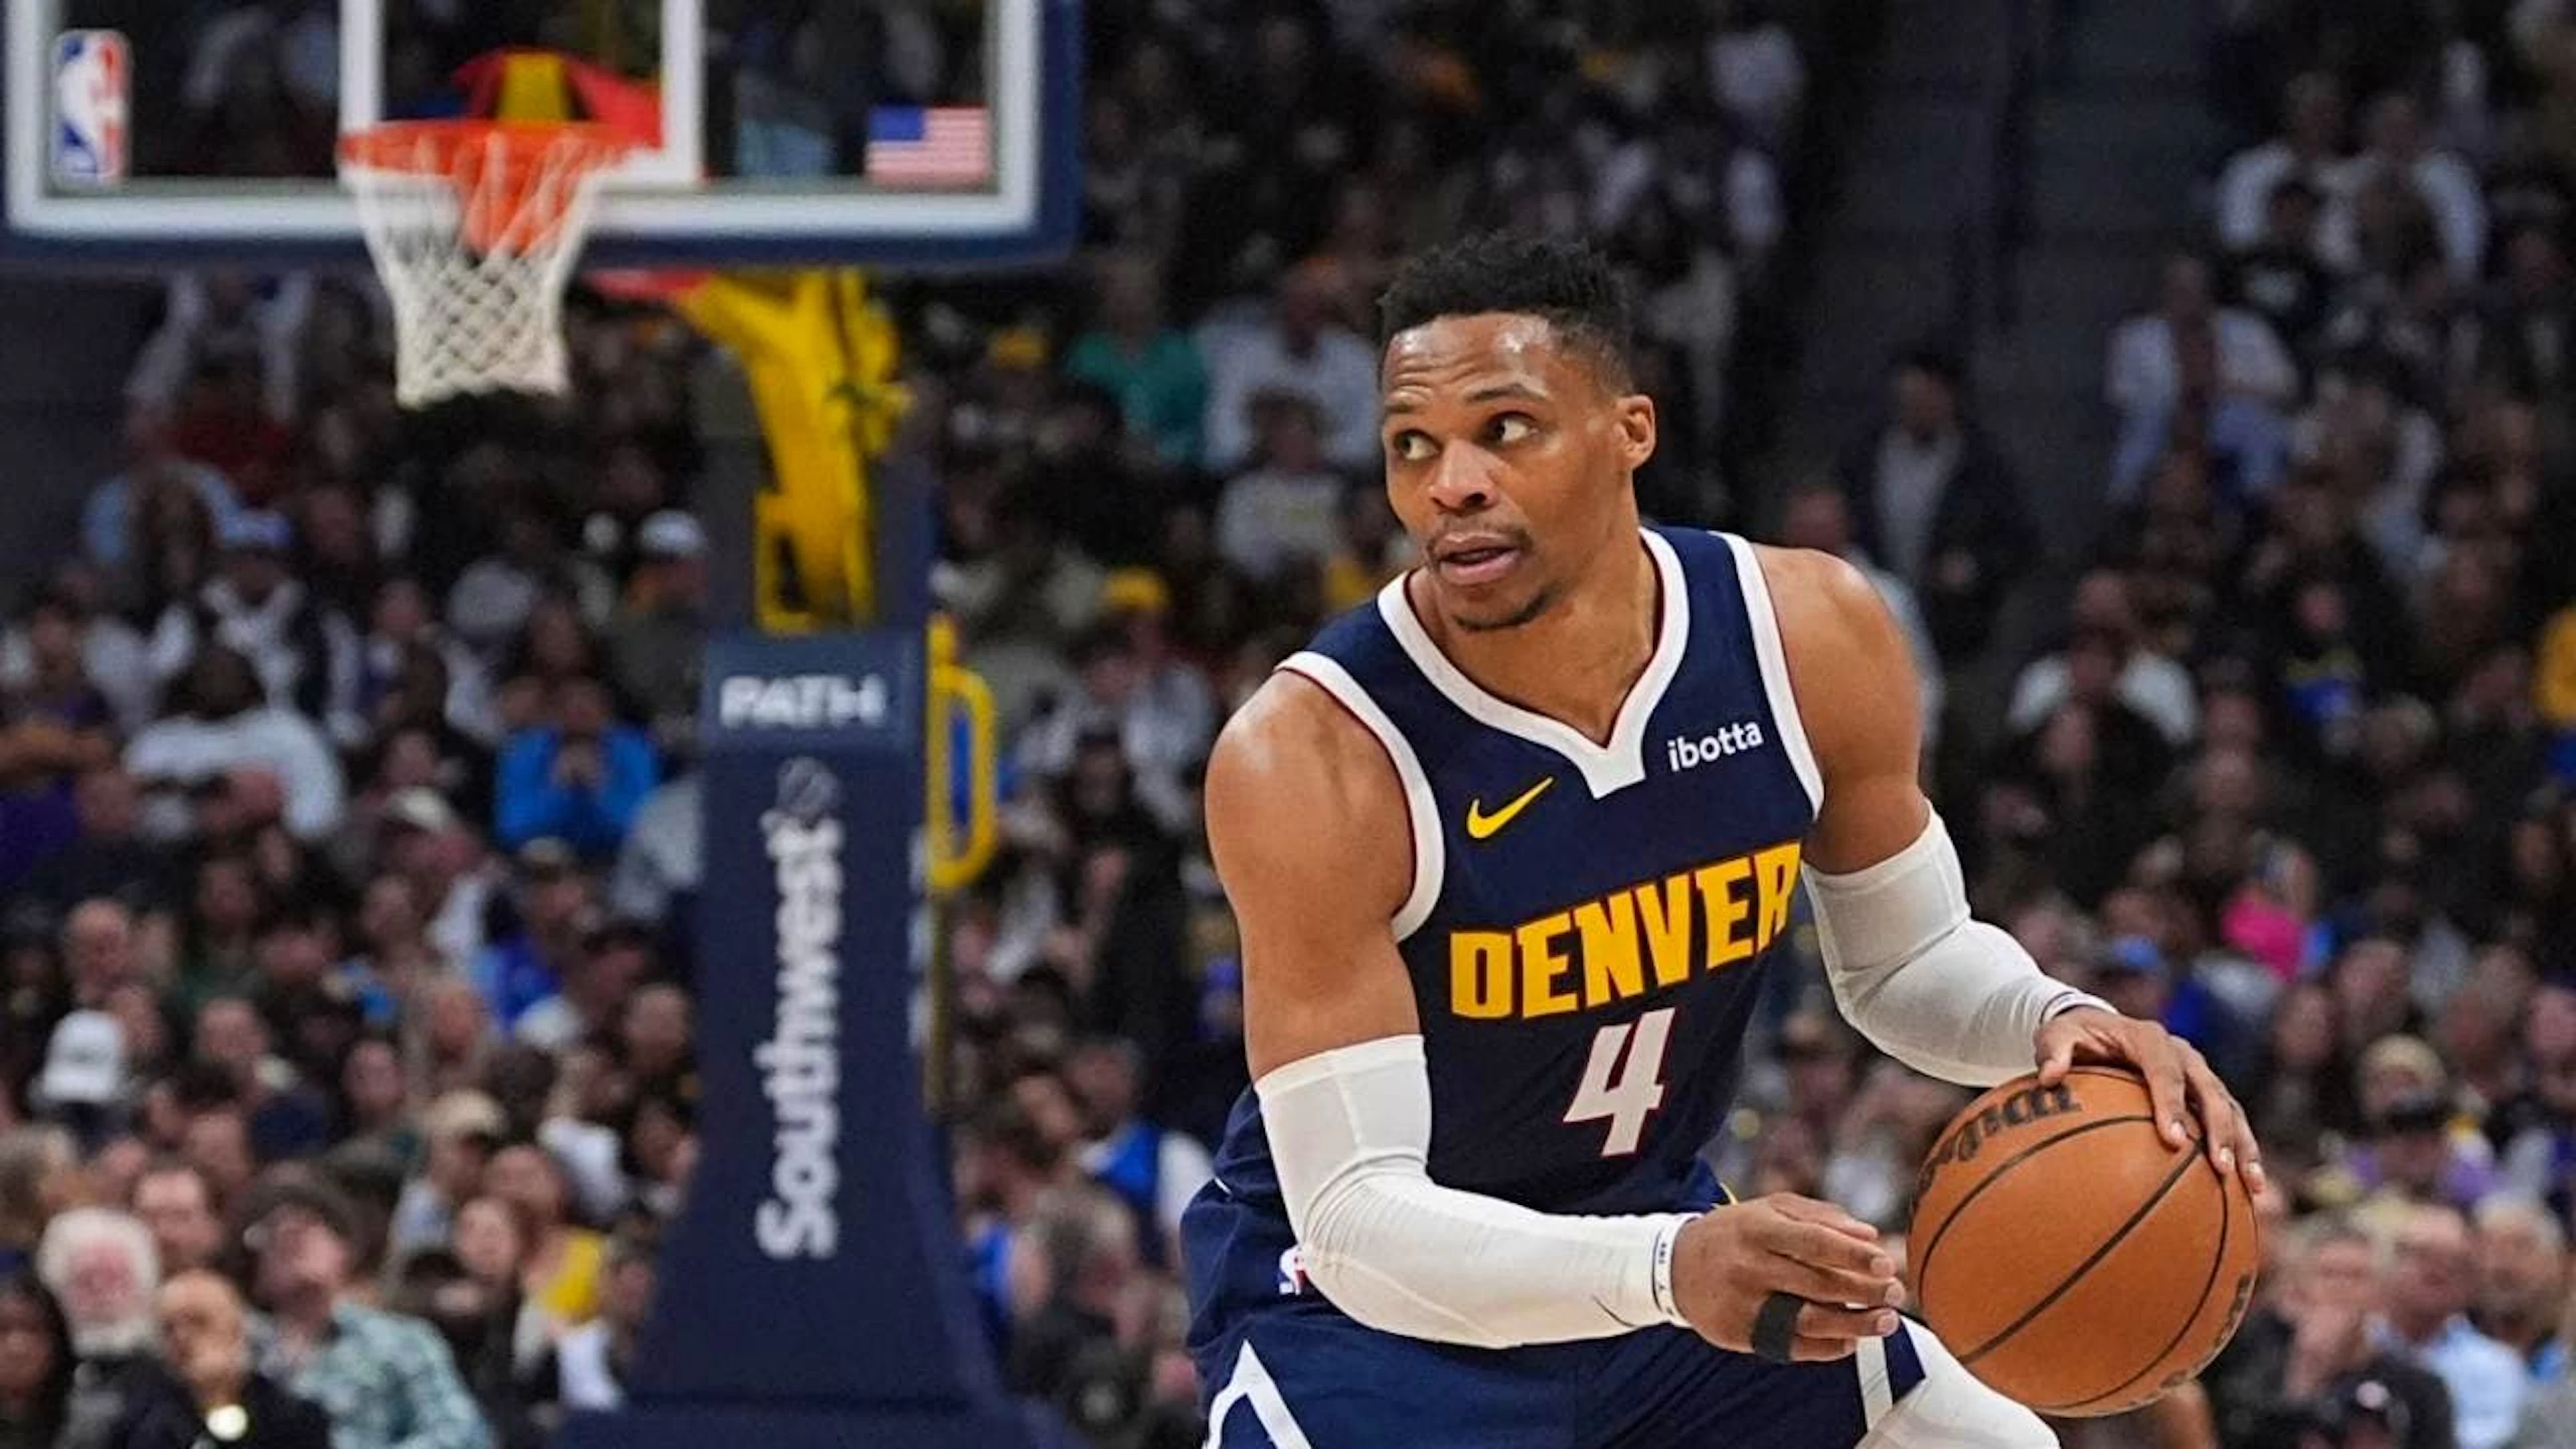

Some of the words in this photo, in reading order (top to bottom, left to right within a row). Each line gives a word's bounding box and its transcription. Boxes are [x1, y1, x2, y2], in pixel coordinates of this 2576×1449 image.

[720, 674, 886, 729] PATH
[1667, 721, 1764, 771] ibotta
[1450, 841, 1802, 1020] DENVER
[753, 809, 843, 1258] Southwest
[1562, 1007, 1676, 1157] 4
